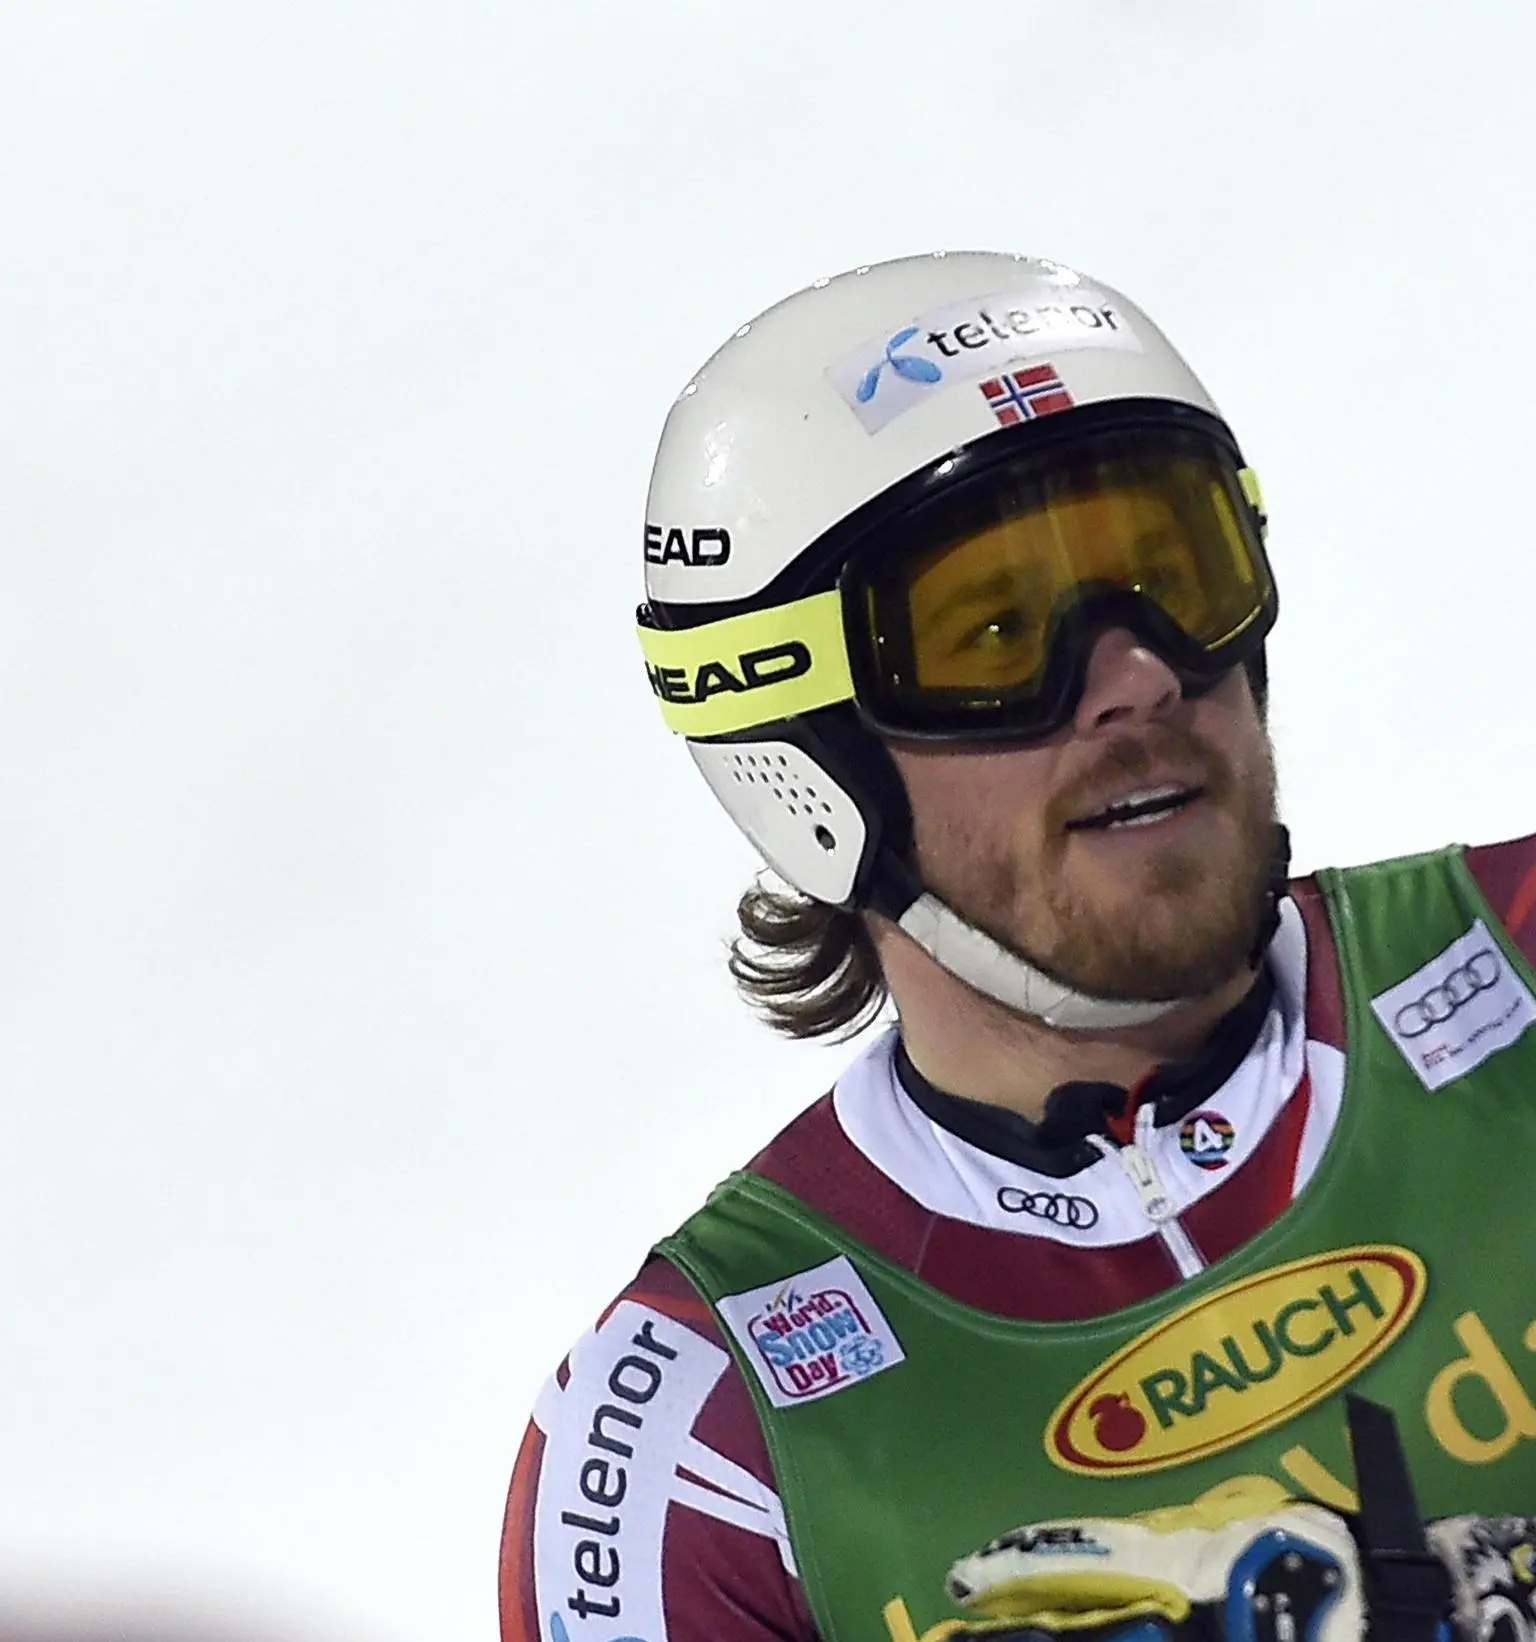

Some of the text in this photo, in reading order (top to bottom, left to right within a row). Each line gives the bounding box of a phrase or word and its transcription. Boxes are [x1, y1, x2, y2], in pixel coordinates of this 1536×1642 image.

[645, 524, 731, 567] EAD
[645, 640, 813, 705] HEAD
[784, 1352, 840, 1391] Day
[1138, 1268, 1385, 1430] RAUCH
[560, 1319, 678, 1620] telenor
